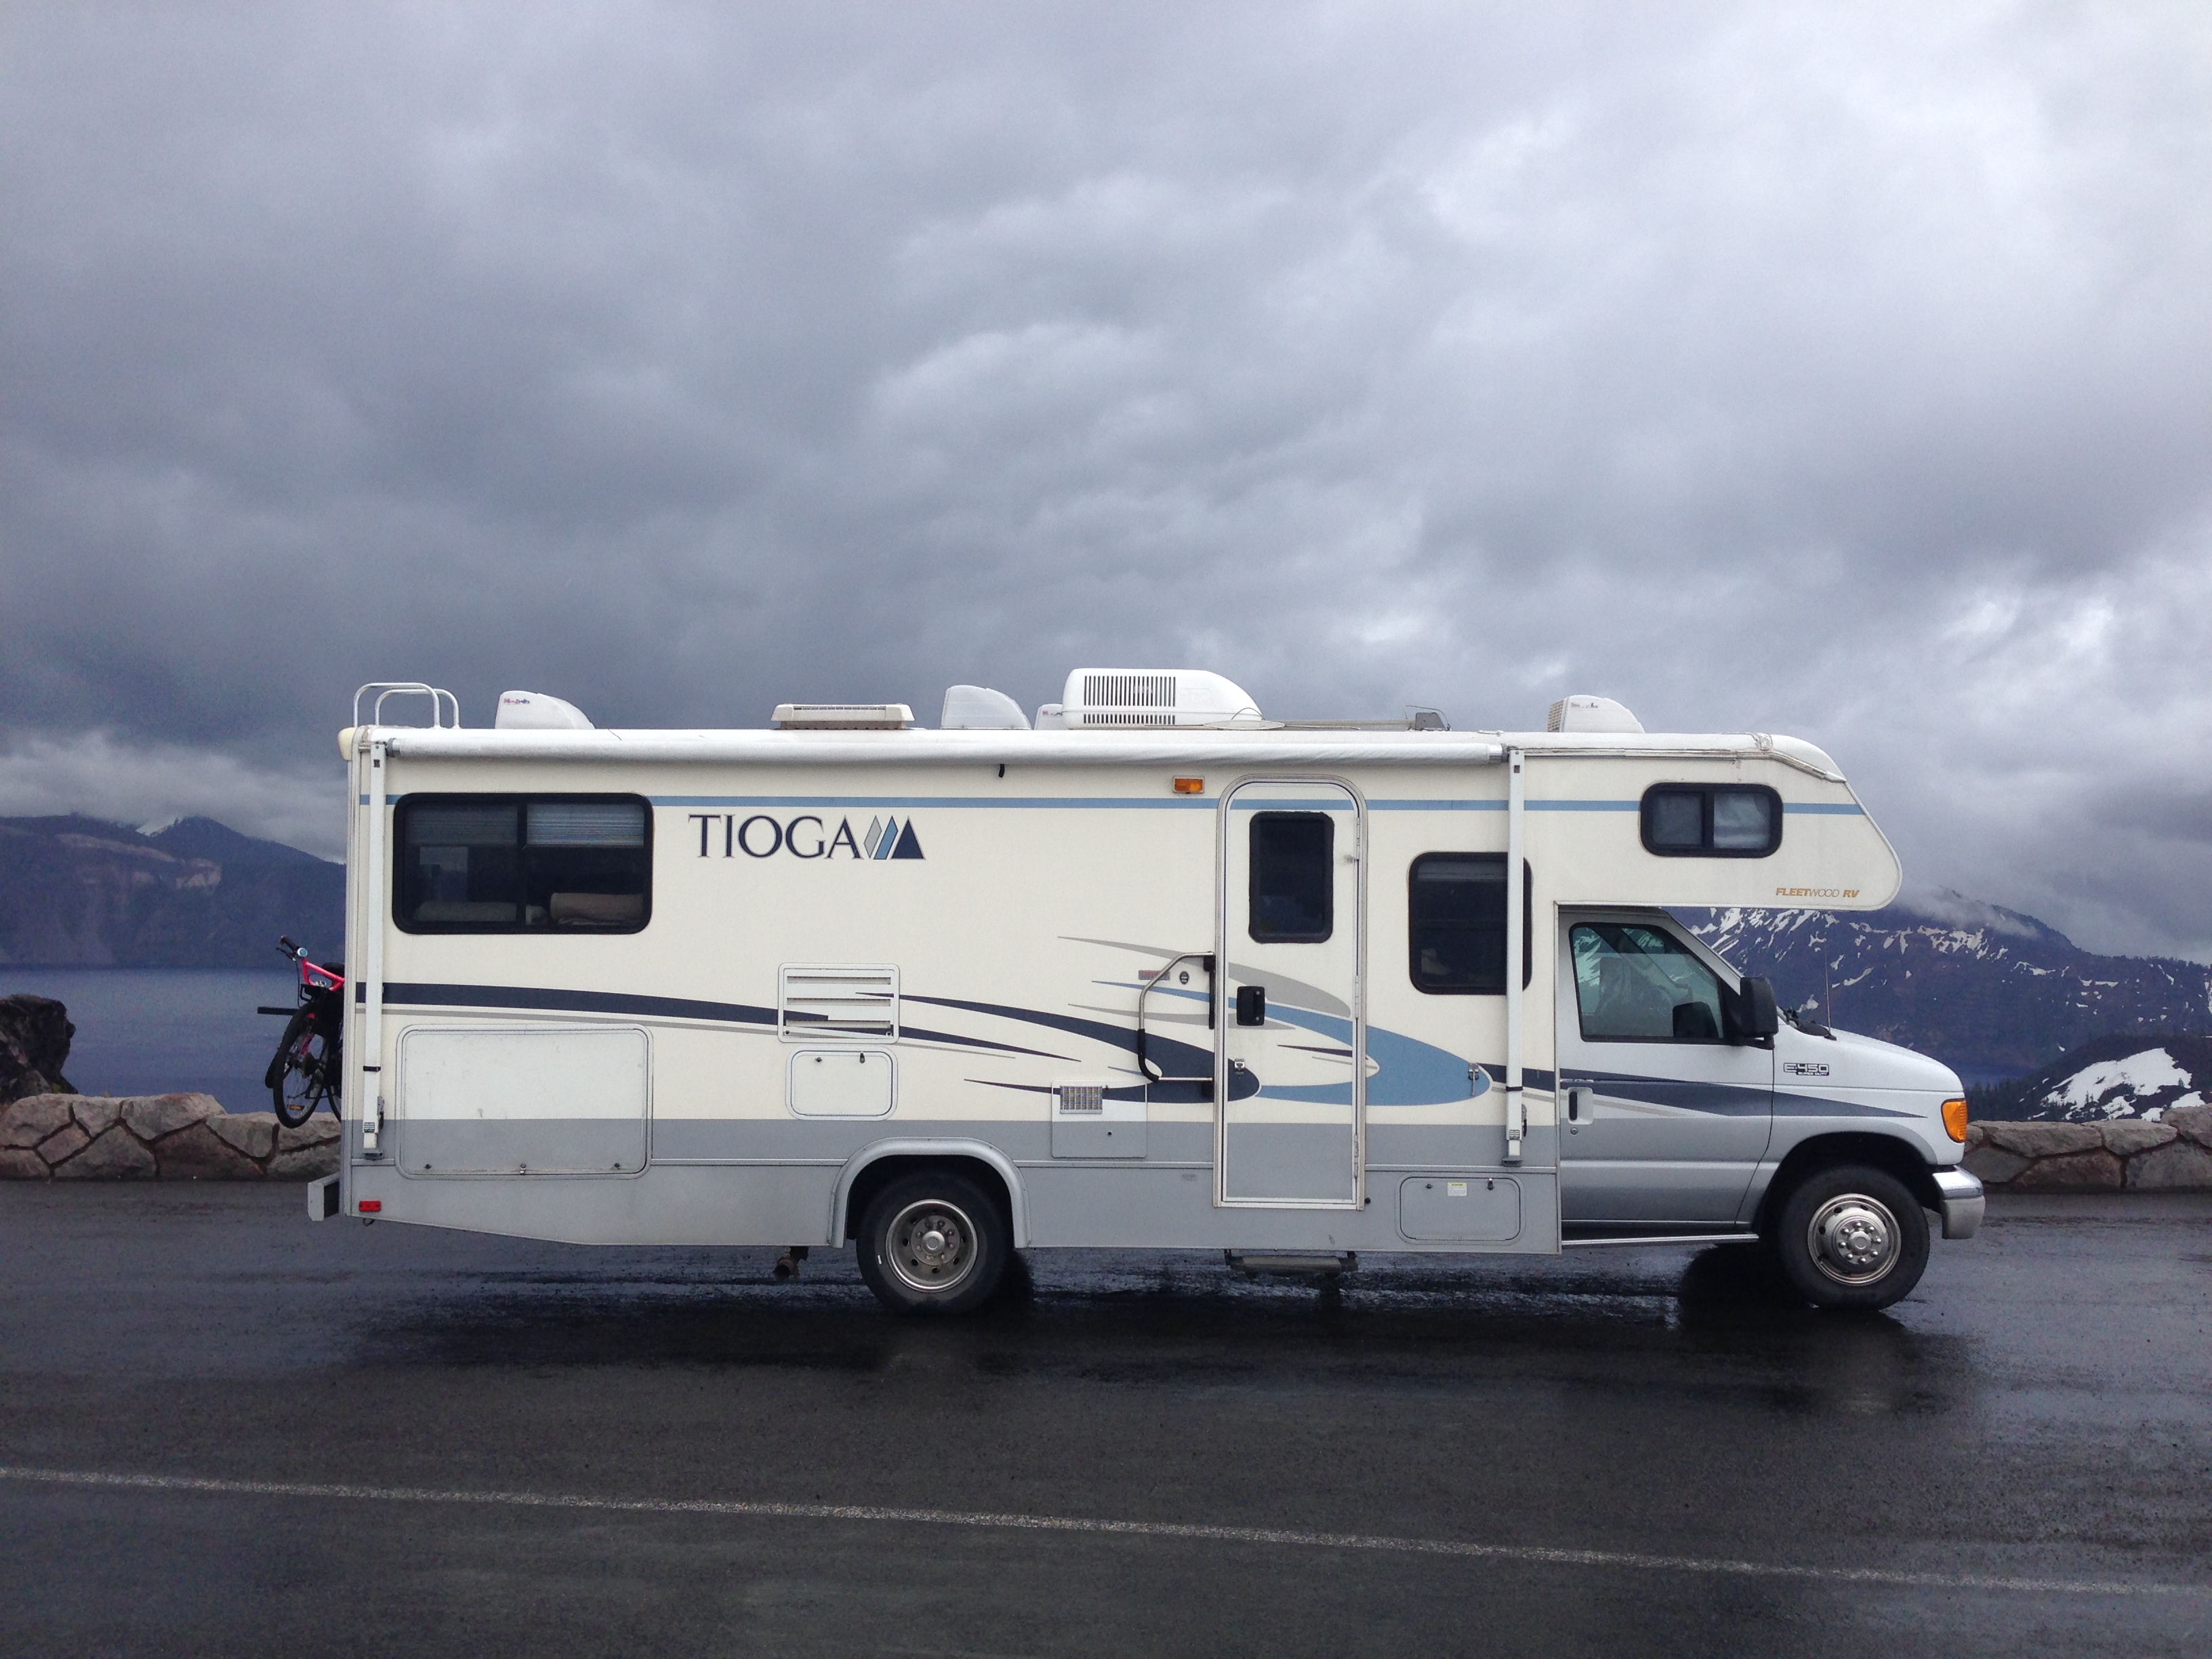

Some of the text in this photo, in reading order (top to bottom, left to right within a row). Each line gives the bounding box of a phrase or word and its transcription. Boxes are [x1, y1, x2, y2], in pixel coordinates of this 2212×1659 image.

[688, 813, 863, 859] TIOGA
[1776, 887, 1860, 898] FLEETWOOD RV
